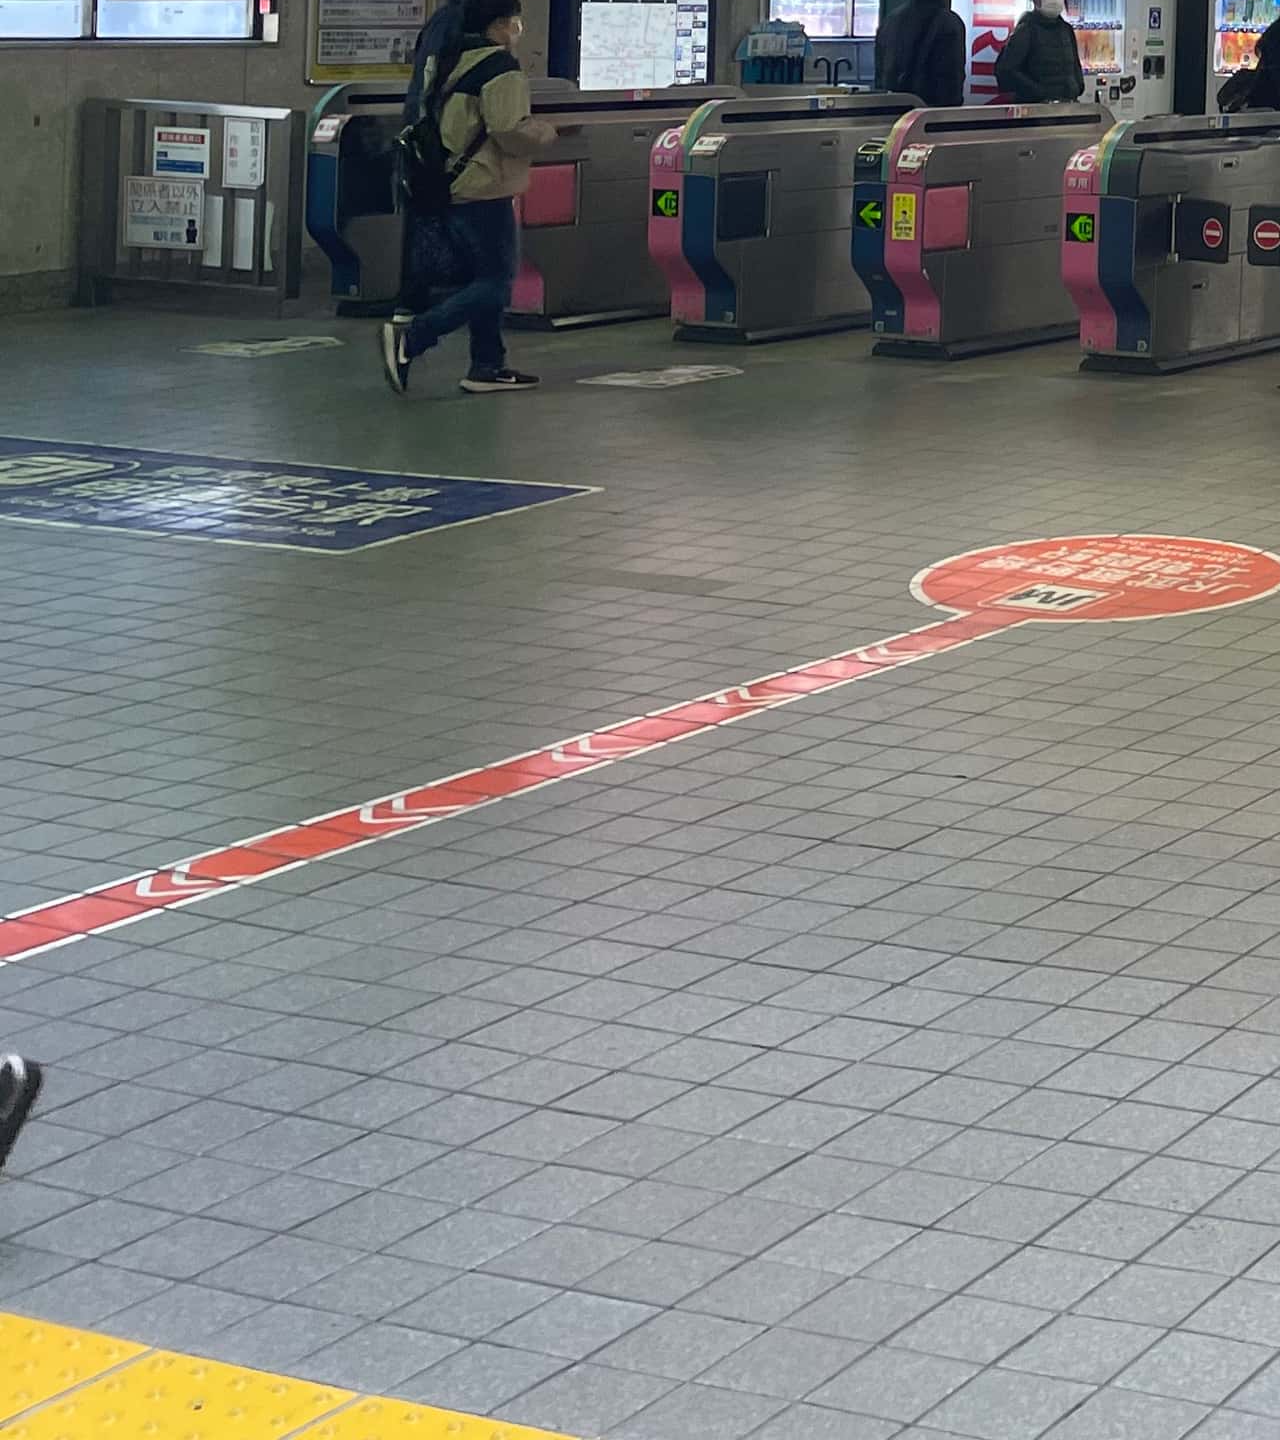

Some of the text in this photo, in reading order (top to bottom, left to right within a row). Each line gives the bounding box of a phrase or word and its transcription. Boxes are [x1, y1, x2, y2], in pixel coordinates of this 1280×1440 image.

[657, 129, 682, 150] IC
[1067, 151, 1095, 171] IC
[1078, 221, 1093, 234] IC
